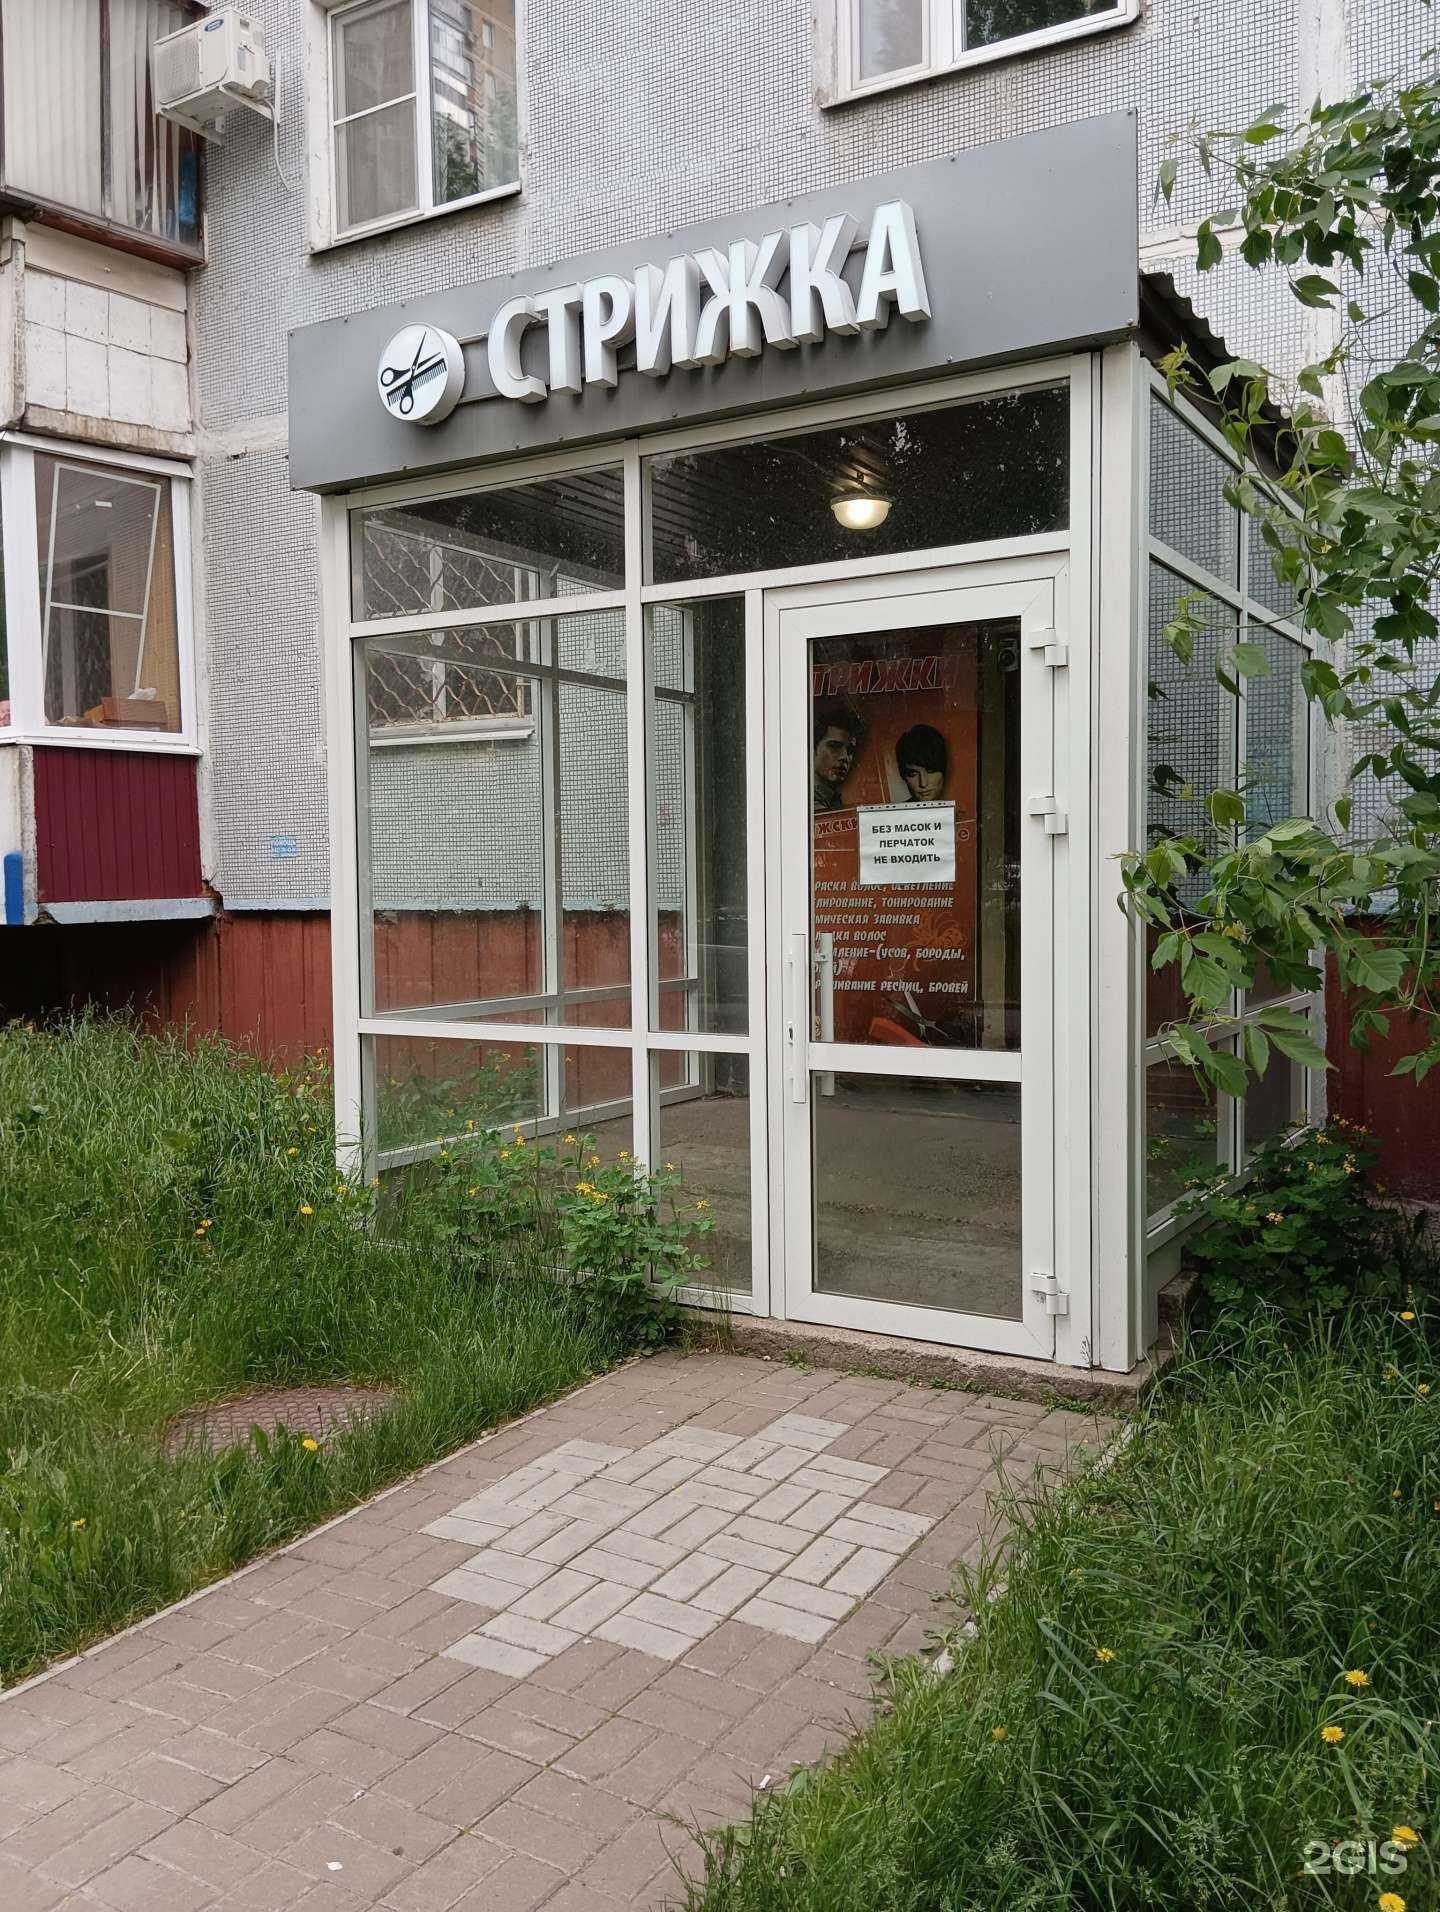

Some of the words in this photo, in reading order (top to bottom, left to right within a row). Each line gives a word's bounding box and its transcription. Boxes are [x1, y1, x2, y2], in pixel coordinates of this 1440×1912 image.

[487, 200, 931, 403] СТРИЖКА
[813, 656, 960, 697] ТРИЖКИ
[872, 825, 892, 834] БЕЗ
[895, 823, 931, 832] МАСОК
[934, 822, 942, 830] И
[879, 838, 935, 848] ПЕРЧАТОК
[874, 855, 888, 864] НЕ
[890, 854, 941, 864] ВХОДИТЬ
[814, 881, 847, 891] РАСКА
[815, 897, 877, 909] ЛИРОВАНИЕ,
[881, 897, 955, 908] ТОНИРОВАНИЕ
[814, 914, 870, 925] МИЧЕСКАЯ
[873, 914, 921, 925] ЗАВИВКА
[853, 930, 888, 942] ВОЛОС
[916, 948, 966, 961] БОРОДЫ,
[880, 980, 924, 993] РЕСНИЦ,
[928, 980, 969, 993] БРОВЕЙ
